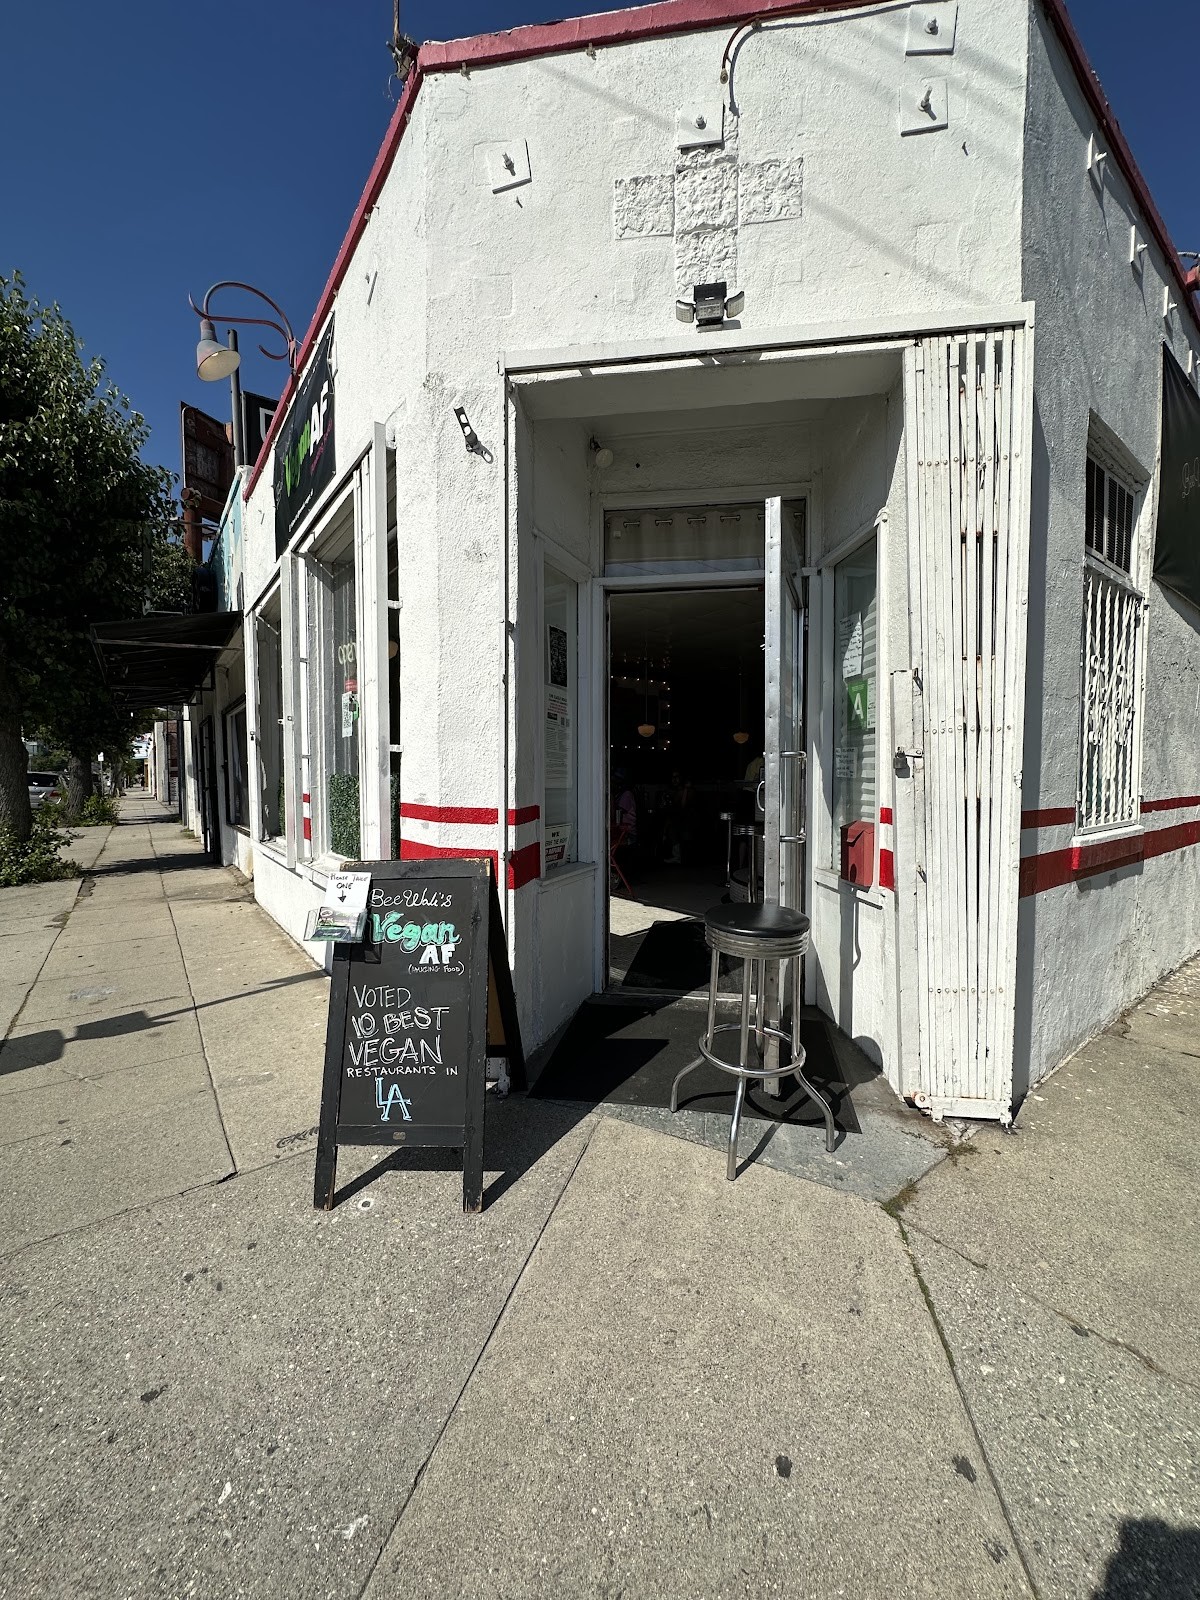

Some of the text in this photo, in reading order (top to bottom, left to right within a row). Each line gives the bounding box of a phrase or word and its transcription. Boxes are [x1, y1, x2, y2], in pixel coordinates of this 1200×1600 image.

[310, 380, 329, 457] AF
[851, 692, 864, 720] A
[336, 882, 354, 890] ONE
[370, 910, 462, 954] Vegan
[419, 943, 456, 965] AF
[352, 984, 412, 1009] VOTED
[351, 1006, 450, 1039] 10 BEST
[348, 1034, 443, 1066] VEGAN
[346, 1065, 458, 1078] RESTAURANTS IN
[374, 1077, 413, 1121] LA
